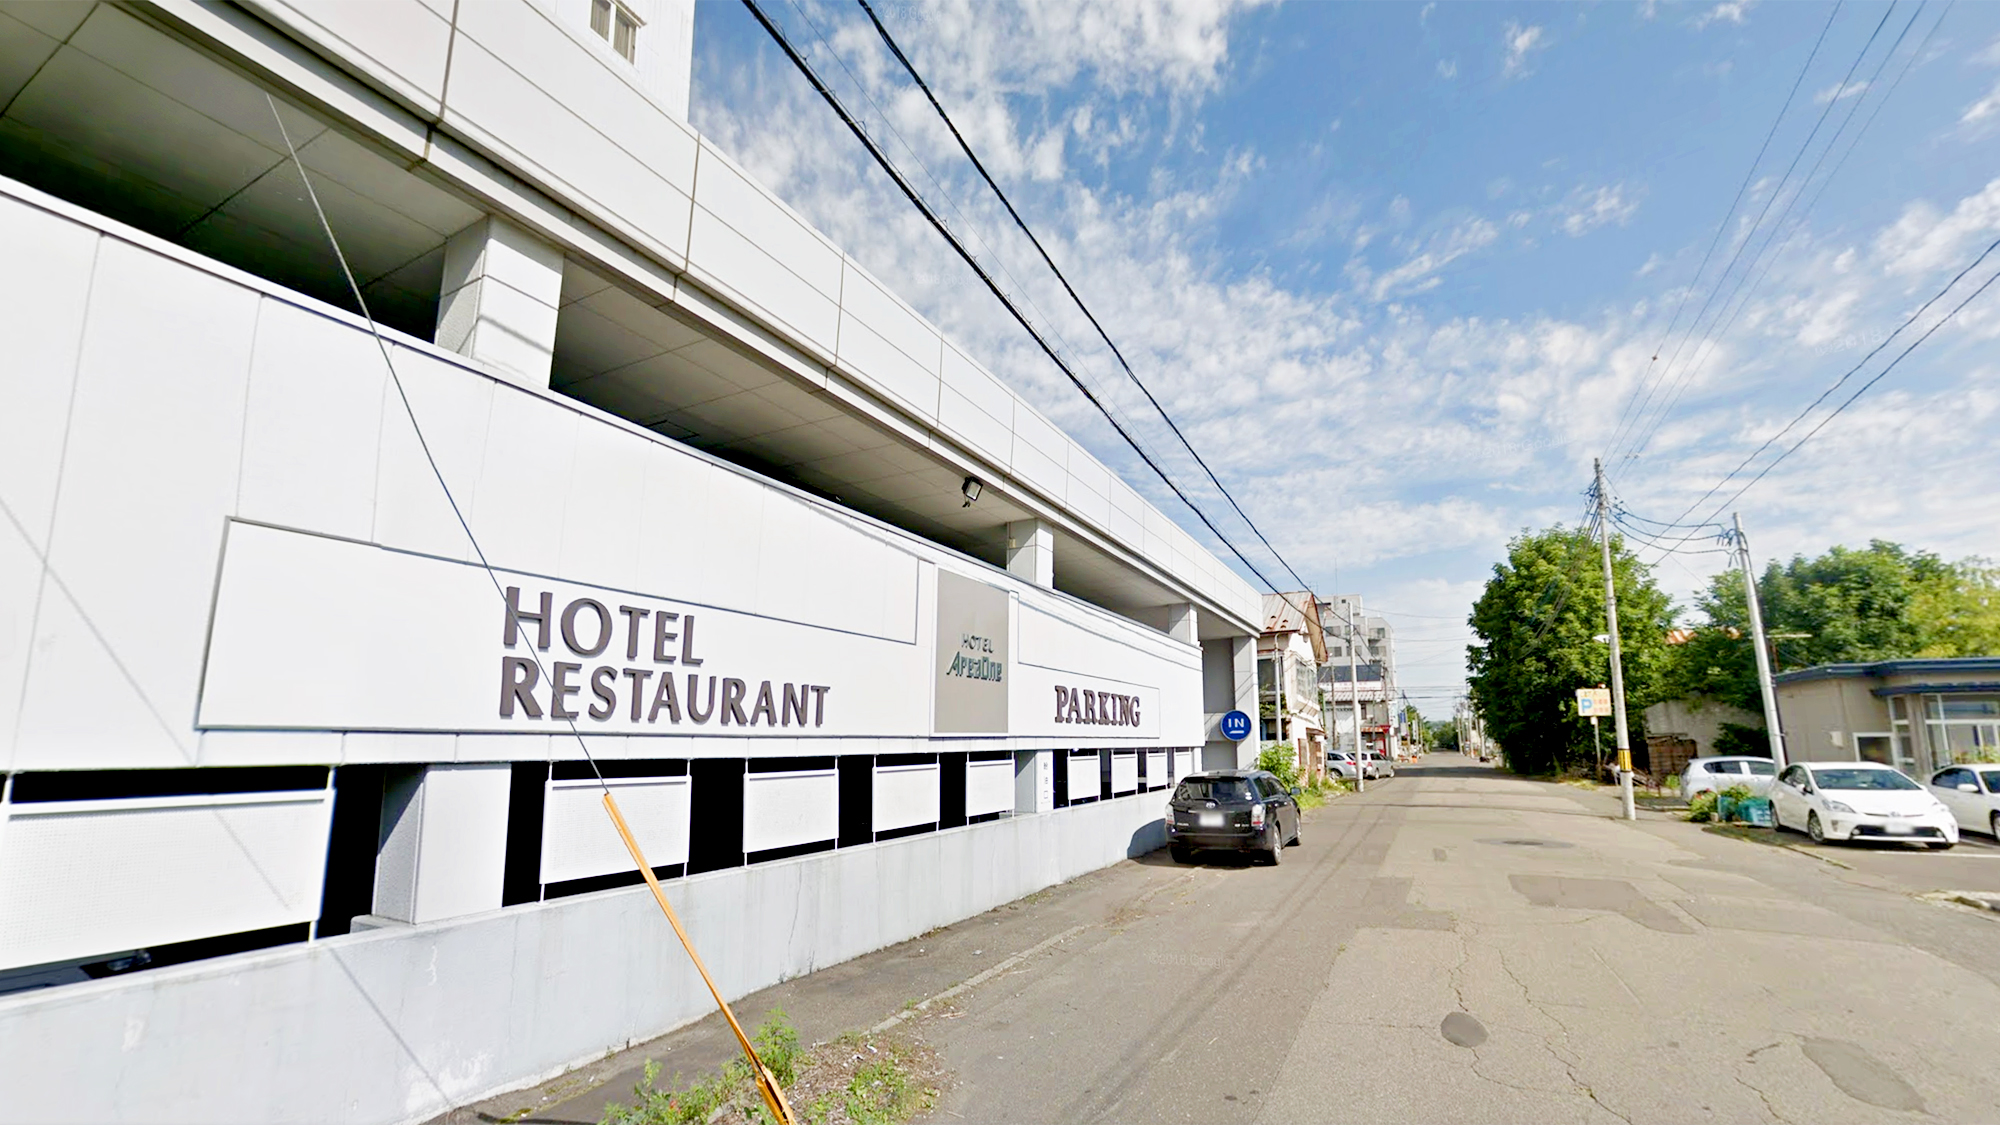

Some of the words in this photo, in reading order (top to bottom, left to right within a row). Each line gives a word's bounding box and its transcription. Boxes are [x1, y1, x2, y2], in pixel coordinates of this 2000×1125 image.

[503, 586, 704, 666] HOTEL
[961, 633, 994, 653] HOTEL
[499, 655, 831, 728] RESTAURANT
[1054, 685, 1141, 728] PARKING
[1581, 698, 1593, 713] P
[1227, 718, 1245, 728] IN
